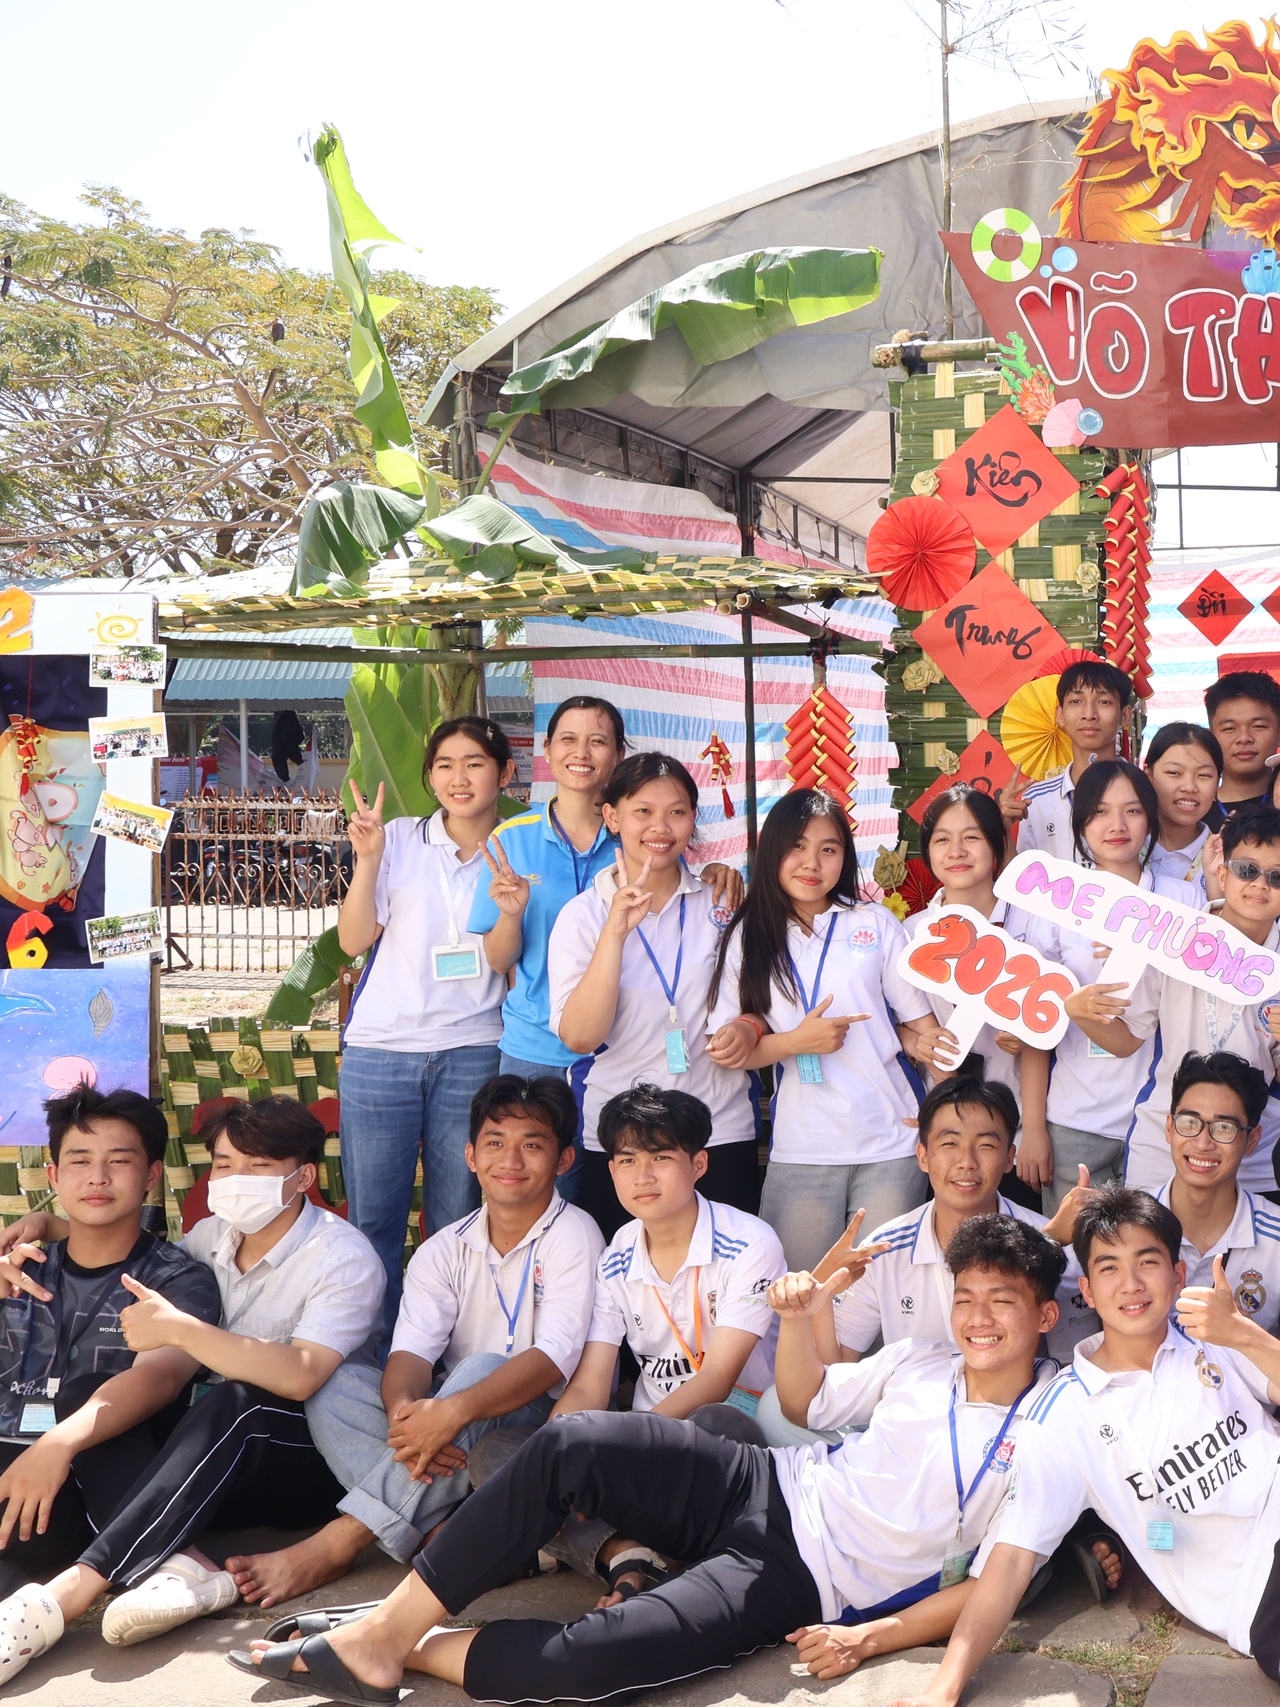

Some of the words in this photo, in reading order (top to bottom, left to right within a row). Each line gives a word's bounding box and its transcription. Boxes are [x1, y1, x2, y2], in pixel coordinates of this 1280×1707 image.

[1015, 270, 1151, 399] VÕ
[7, 911, 54, 969] 6
[908, 914, 1073, 1034] 2026
[1016, 861, 1105, 926] MẸ
[1104, 896, 1275, 996] PHƯƠNG
[1125, 1410, 1248, 1502] Emirates
[1197, 1449, 1248, 1501] BETTER
